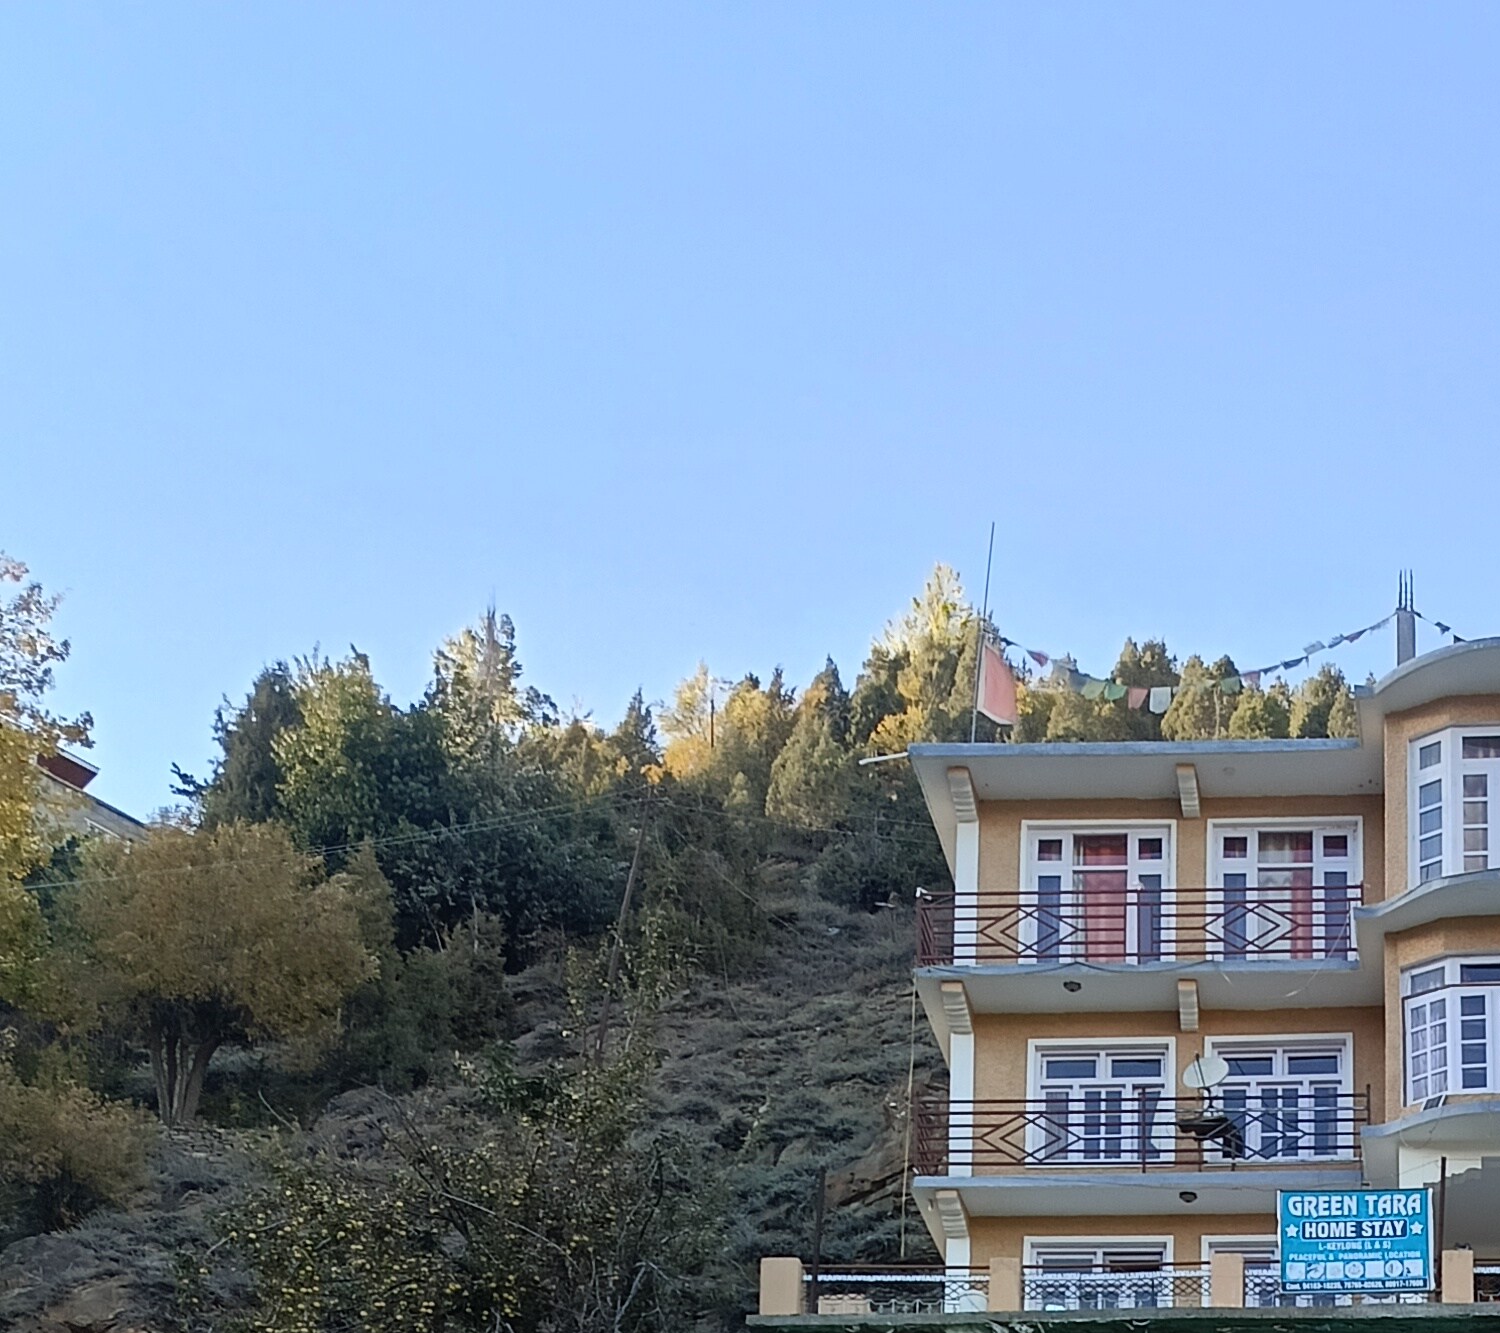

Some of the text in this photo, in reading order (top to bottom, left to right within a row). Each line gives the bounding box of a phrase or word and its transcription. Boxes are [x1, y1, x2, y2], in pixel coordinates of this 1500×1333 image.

[1288, 1193, 1421, 1217] GREEN TARA
[1304, 1220, 1404, 1238] HOME STAY
[1288, 1253, 1327, 1261] PEACEFUL
[1338, 1252, 1383, 1260] PANORAMIC
[1384, 1251, 1421, 1260] LOCATION
